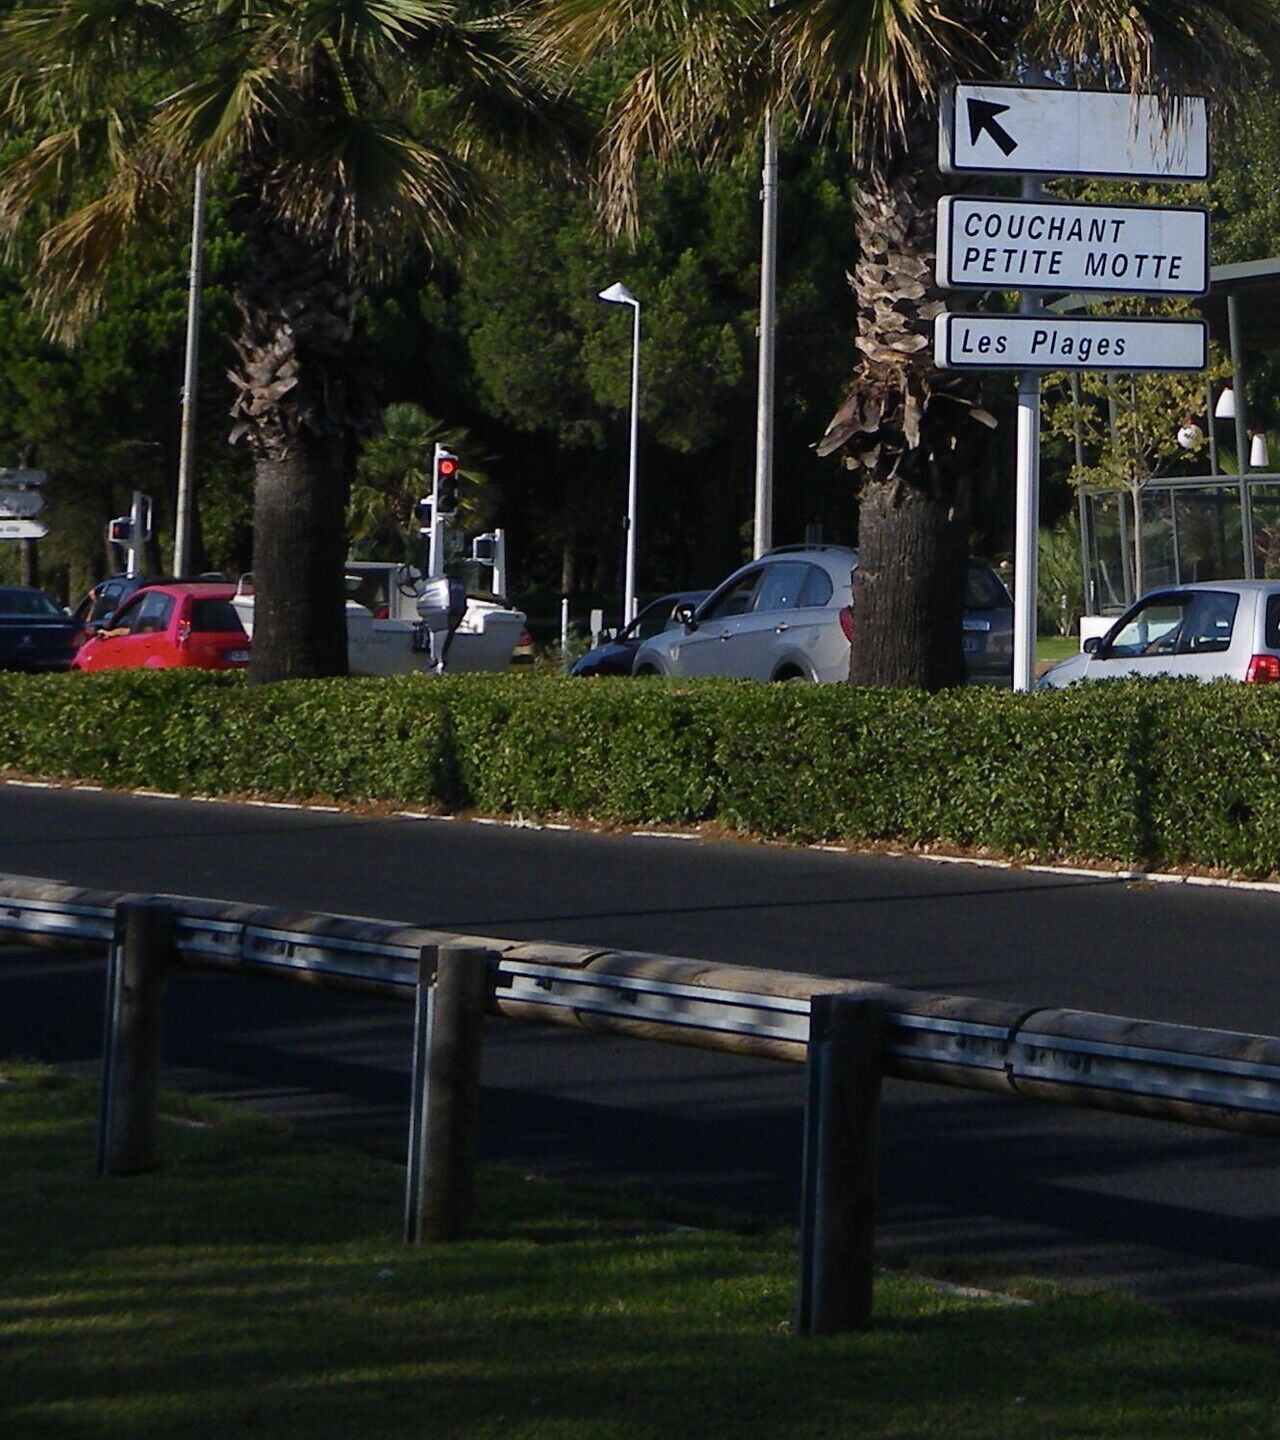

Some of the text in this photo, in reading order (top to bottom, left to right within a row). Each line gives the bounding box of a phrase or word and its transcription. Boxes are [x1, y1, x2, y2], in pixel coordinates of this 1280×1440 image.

[964, 212, 1125, 243] COUCHANT
[962, 247, 1182, 279] PETITE MOTTE
[961, 328, 1126, 362] Les Plages
